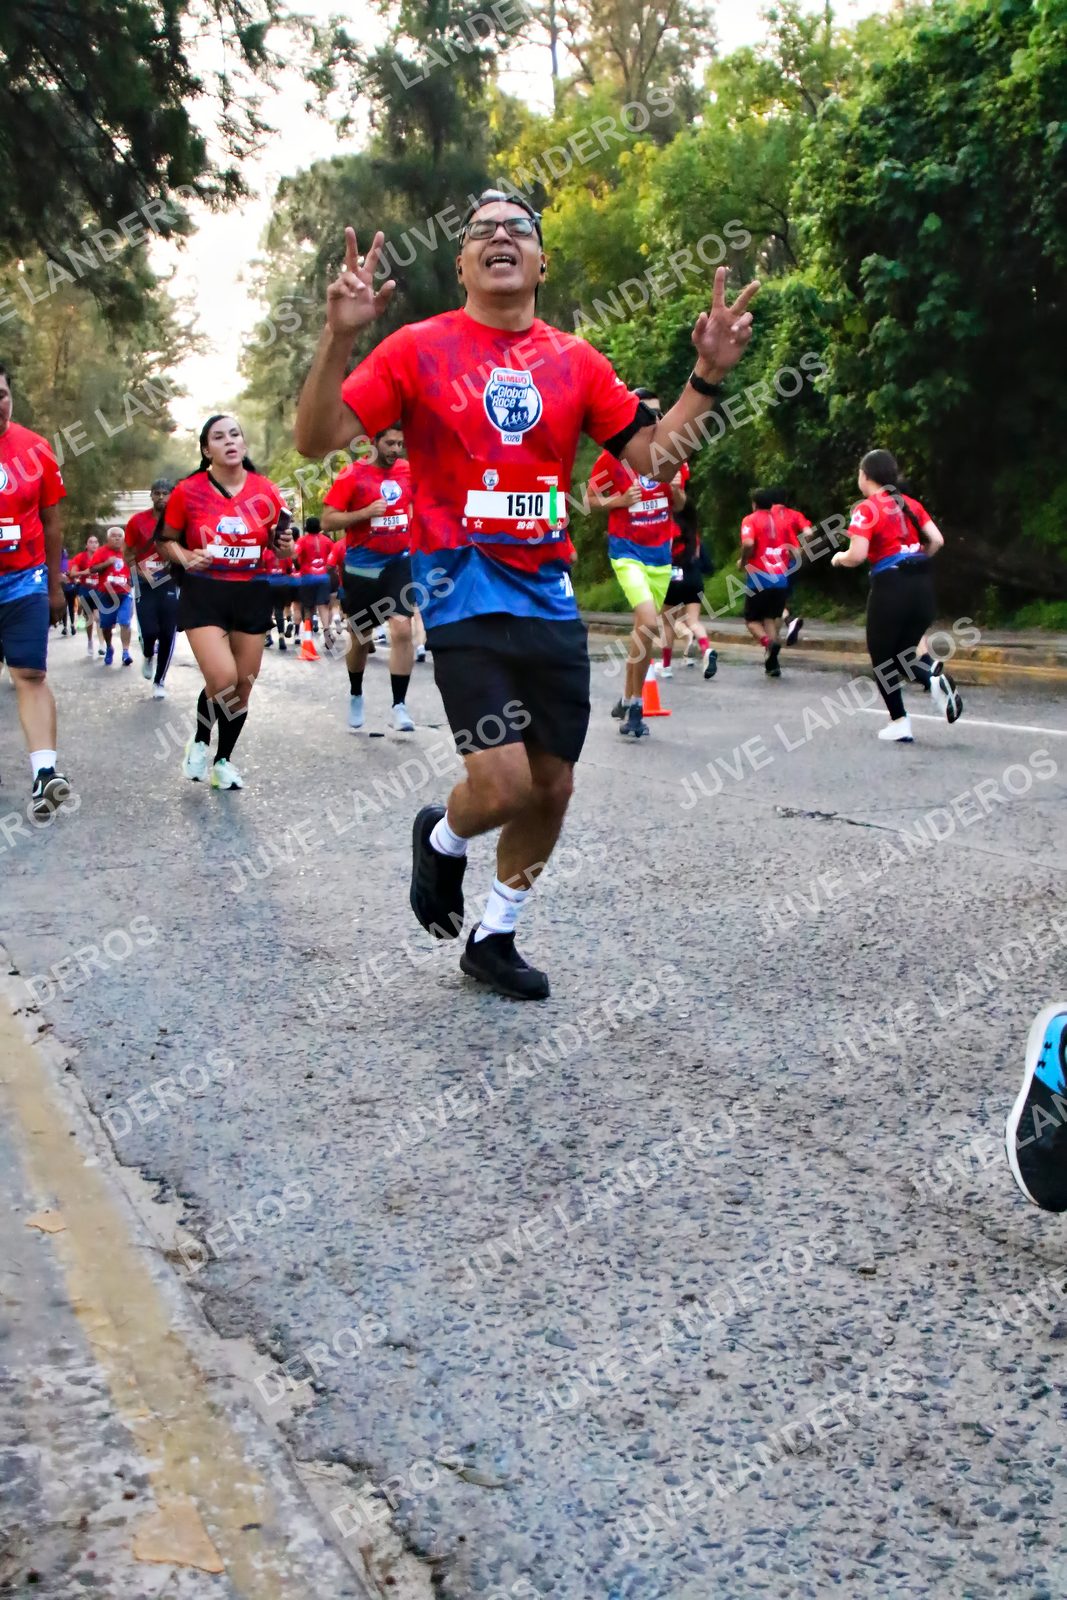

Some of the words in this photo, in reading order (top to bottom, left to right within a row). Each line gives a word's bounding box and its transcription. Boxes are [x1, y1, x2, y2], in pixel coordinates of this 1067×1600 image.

[497, 374, 527, 384] BIMBO
[497, 386, 528, 400] Global
[492, 396, 516, 408] Race
[504, 434, 520, 442] 2026
[507, 494, 544, 517] 1510
[223, 547, 246, 558] 2477
